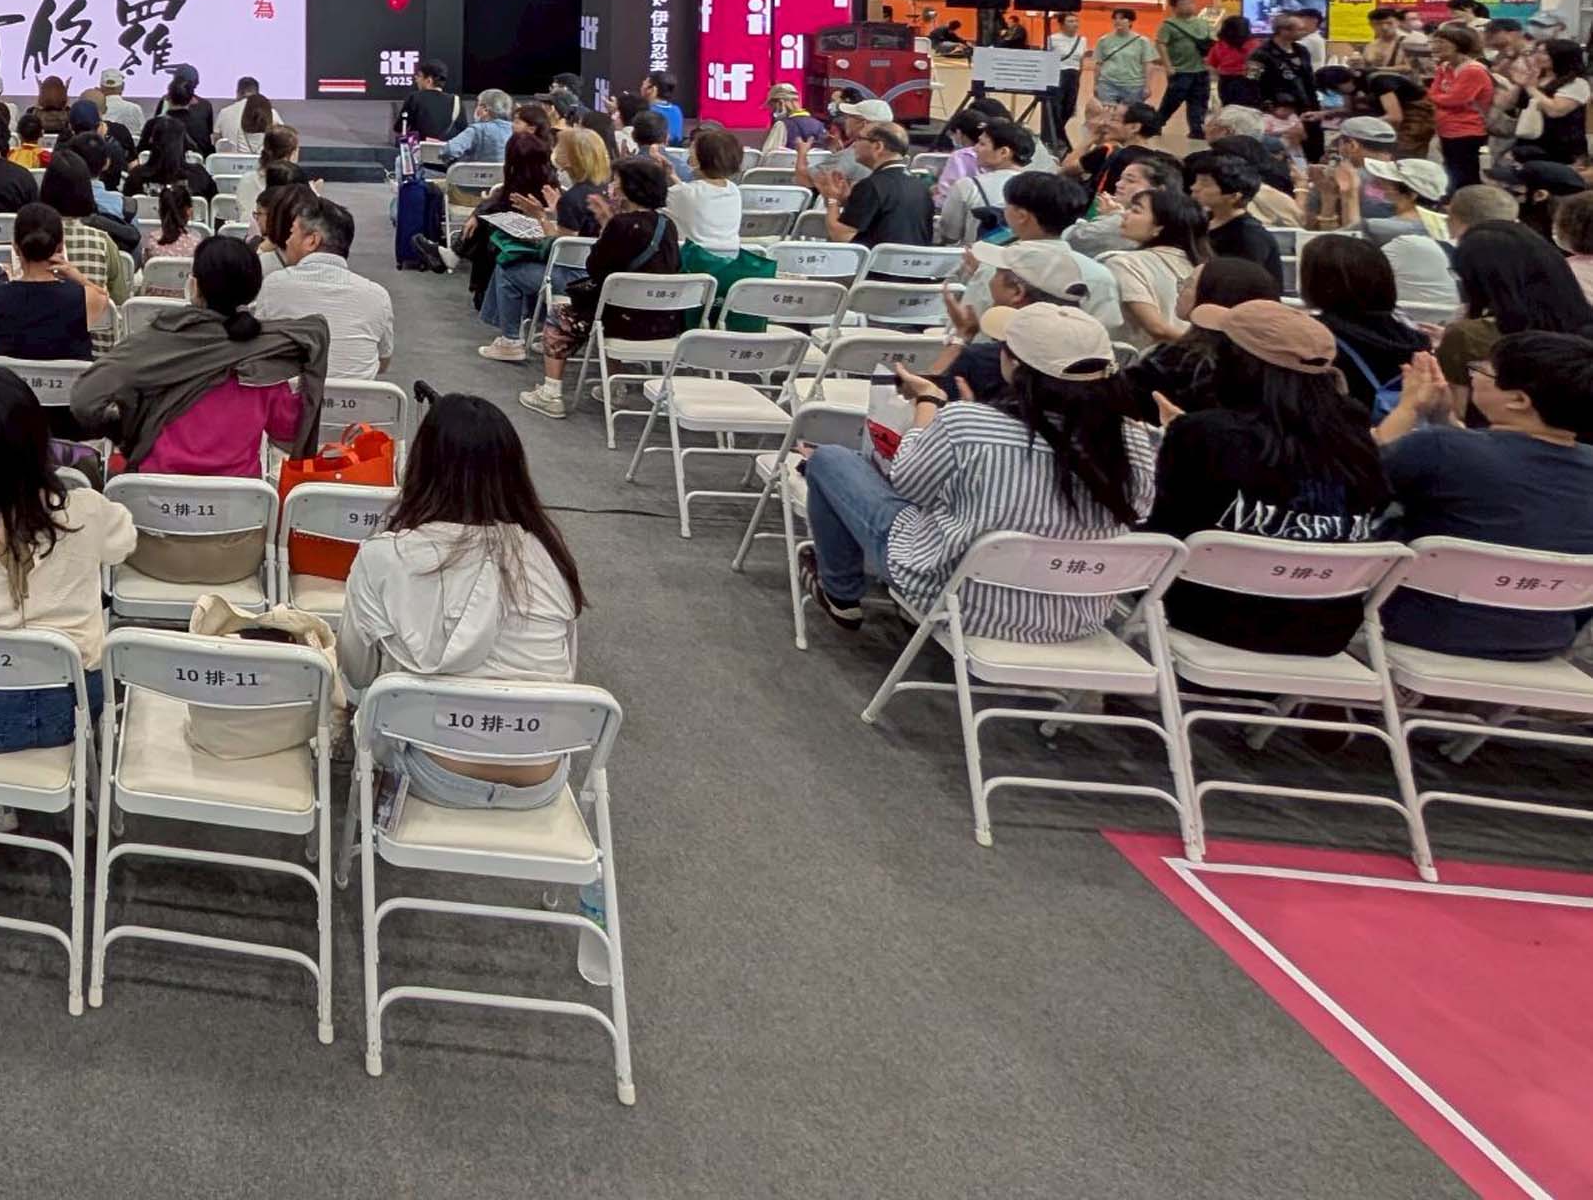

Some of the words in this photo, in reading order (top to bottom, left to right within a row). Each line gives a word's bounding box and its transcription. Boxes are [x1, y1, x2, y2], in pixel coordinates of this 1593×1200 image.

[380, 50, 419, 74] itf
[385, 76, 413, 86] 2025
[708, 63, 754, 100] itf
